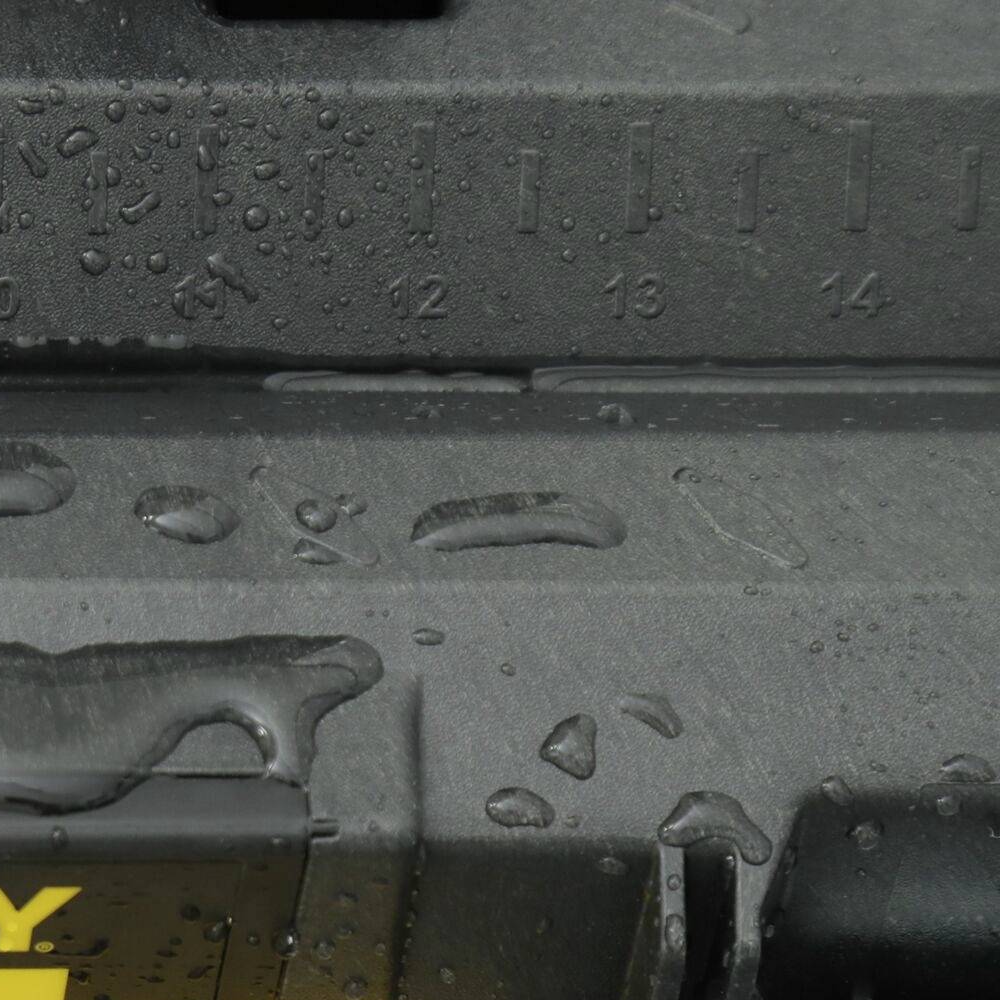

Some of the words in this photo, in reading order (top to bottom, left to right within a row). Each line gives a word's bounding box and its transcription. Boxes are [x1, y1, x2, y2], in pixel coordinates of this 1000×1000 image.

[390, 274, 449, 319] 12
[603, 272, 667, 319] 13
[820, 270, 892, 319] 14
